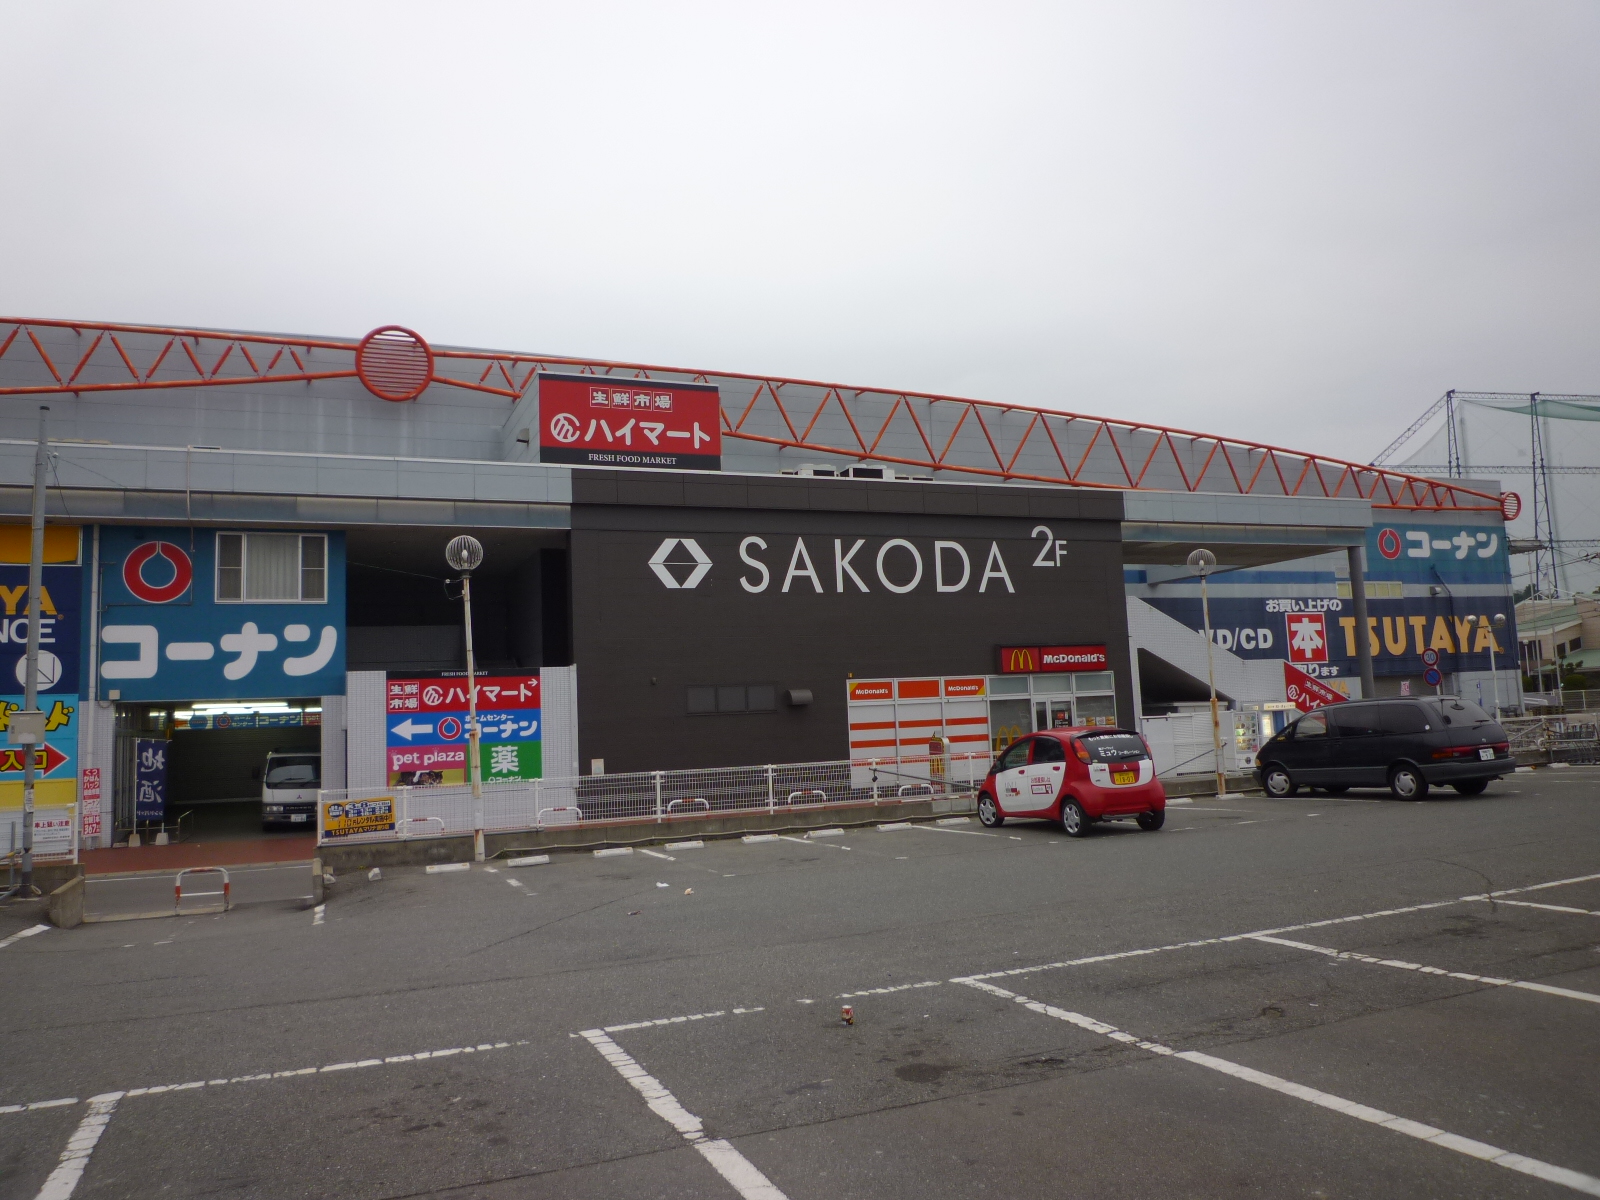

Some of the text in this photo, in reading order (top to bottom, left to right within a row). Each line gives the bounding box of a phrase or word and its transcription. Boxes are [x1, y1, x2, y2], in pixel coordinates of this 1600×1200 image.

[592, 391, 671, 409] 生鮮市場
[584, 418, 711, 449] ハイマート
[588, 453, 677, 465] FRESH FOOD MARKET
[1405, 530, 1498, 560] コーナン
[739, 525, 1068, 594] SAKODA 2F
[1265, 598, 1342, 613] お買い上げの
[1290, 617, 1324, 659] 本
[1338, 615, 1500, 657] TSUTAYA
[101, 621, 338, 681] コーナン
[1043, 653, 1106, 664] McDonald's
[1424, 652, 1436, 662] 30
[390, 685, 418, 695] 生鮮
[445, 683, 532, 703] ハイマート
[390, 698, 418, 709] 市場
[258, 715, 301, 725] コーナン
[464, 714, 515, 722] ホームセンター
[463, 720, 538, 739] コーナン
[392, 751, 465, 771] pet plaza
[490, 746, 520, 774] 薬
[1099, 749, 1117, 757] ミュウ
